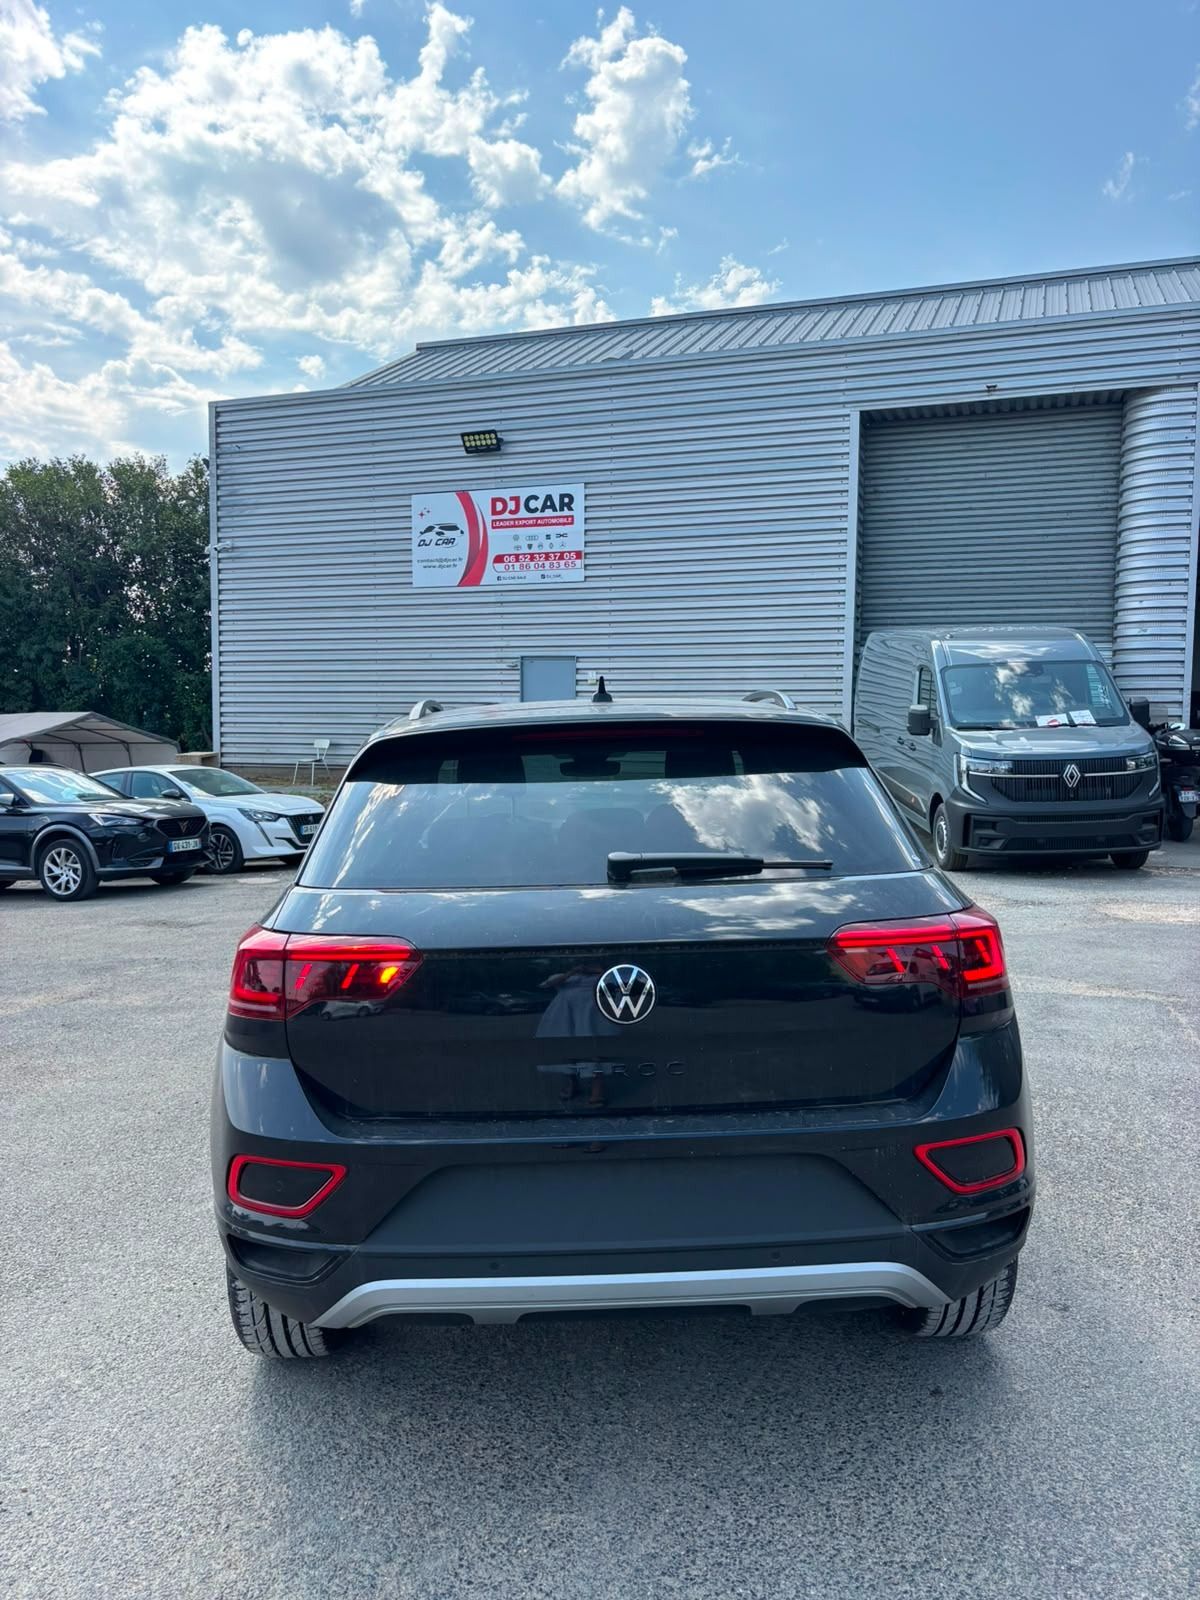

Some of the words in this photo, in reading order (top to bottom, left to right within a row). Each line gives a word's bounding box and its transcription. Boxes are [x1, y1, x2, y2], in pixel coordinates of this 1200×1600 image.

[490, 495, 521, 516] DJ
[523, 492, 575, 514] CAR
[493, 519, 514, 527] LEADER
[515, 518, 537, 526] EXPORT
[537, 516, 573, 525] AUTOMOBILE
[417, 538, 433, 547] DJ
[434, 537, 456, 547] CAR
[503, 555, 516, 563] 06
[518, 554, 531, 562] 52
[533, 553, 546, 561] 32
[548, 553, 561, 561] 37
[563, 552, 577, 560] 05
[504, 563, 516, 571] 01
[518, 562, 531, 570] 86
[533, 562, 546, 570] 04
[548, 561, 561, 569] 83
[563, 560, 577, 568] 65
